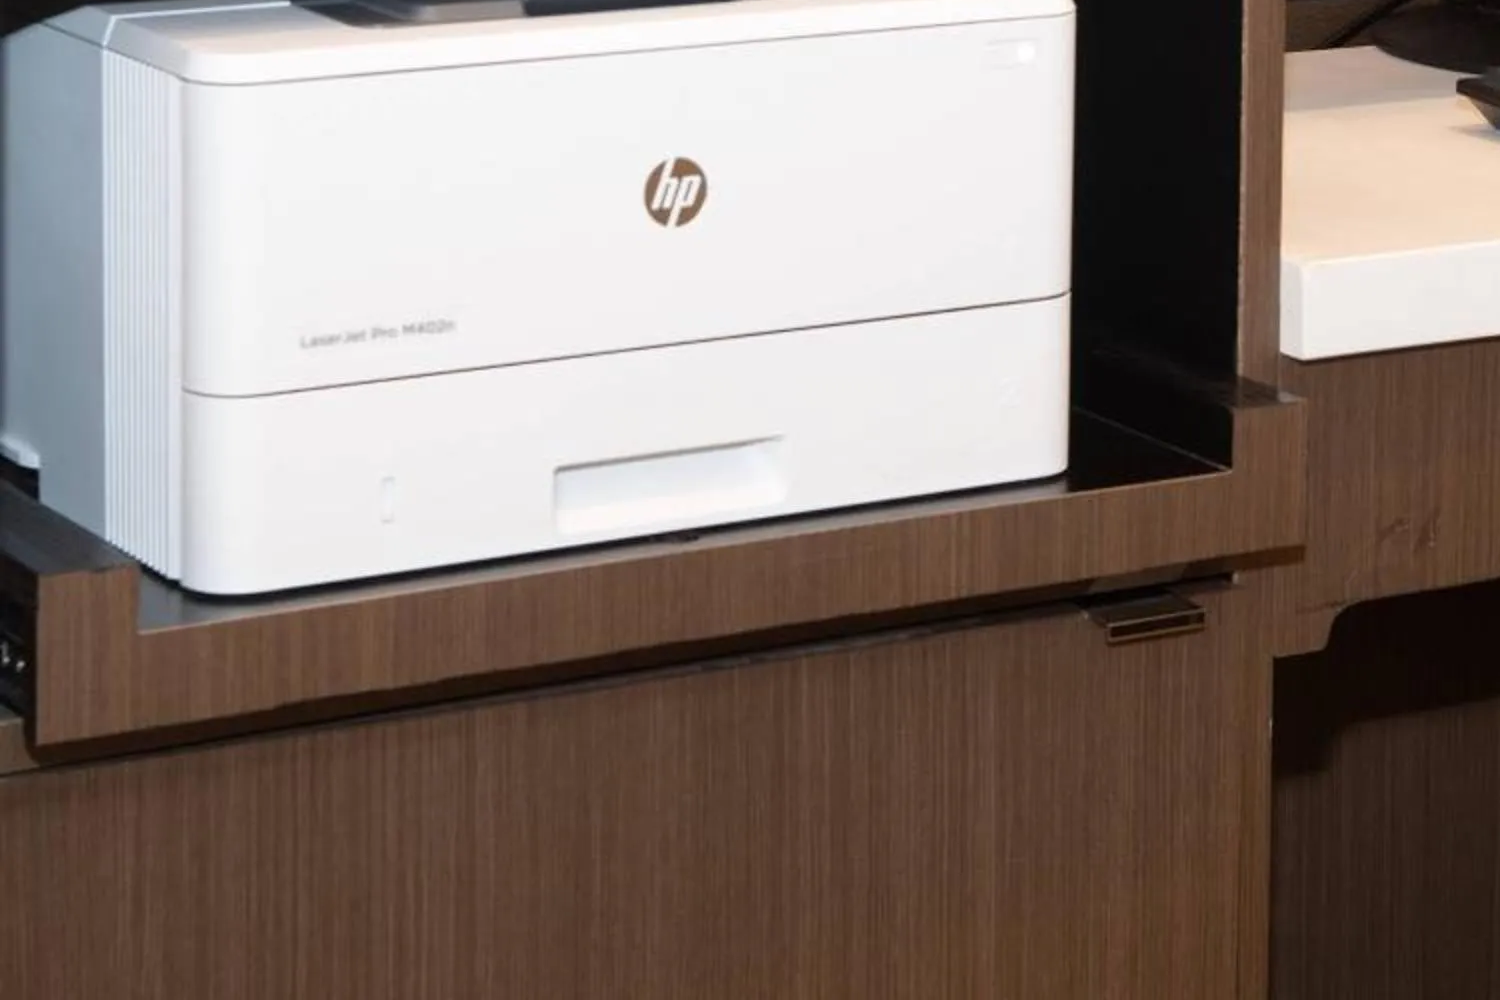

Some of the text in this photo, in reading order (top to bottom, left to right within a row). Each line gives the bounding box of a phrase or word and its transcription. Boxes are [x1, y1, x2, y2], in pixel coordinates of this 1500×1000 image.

[643, 156, 708, 228] hp
[300, 329, 367, 349] LaserJet
[371, 325, 399, 341] Pro
